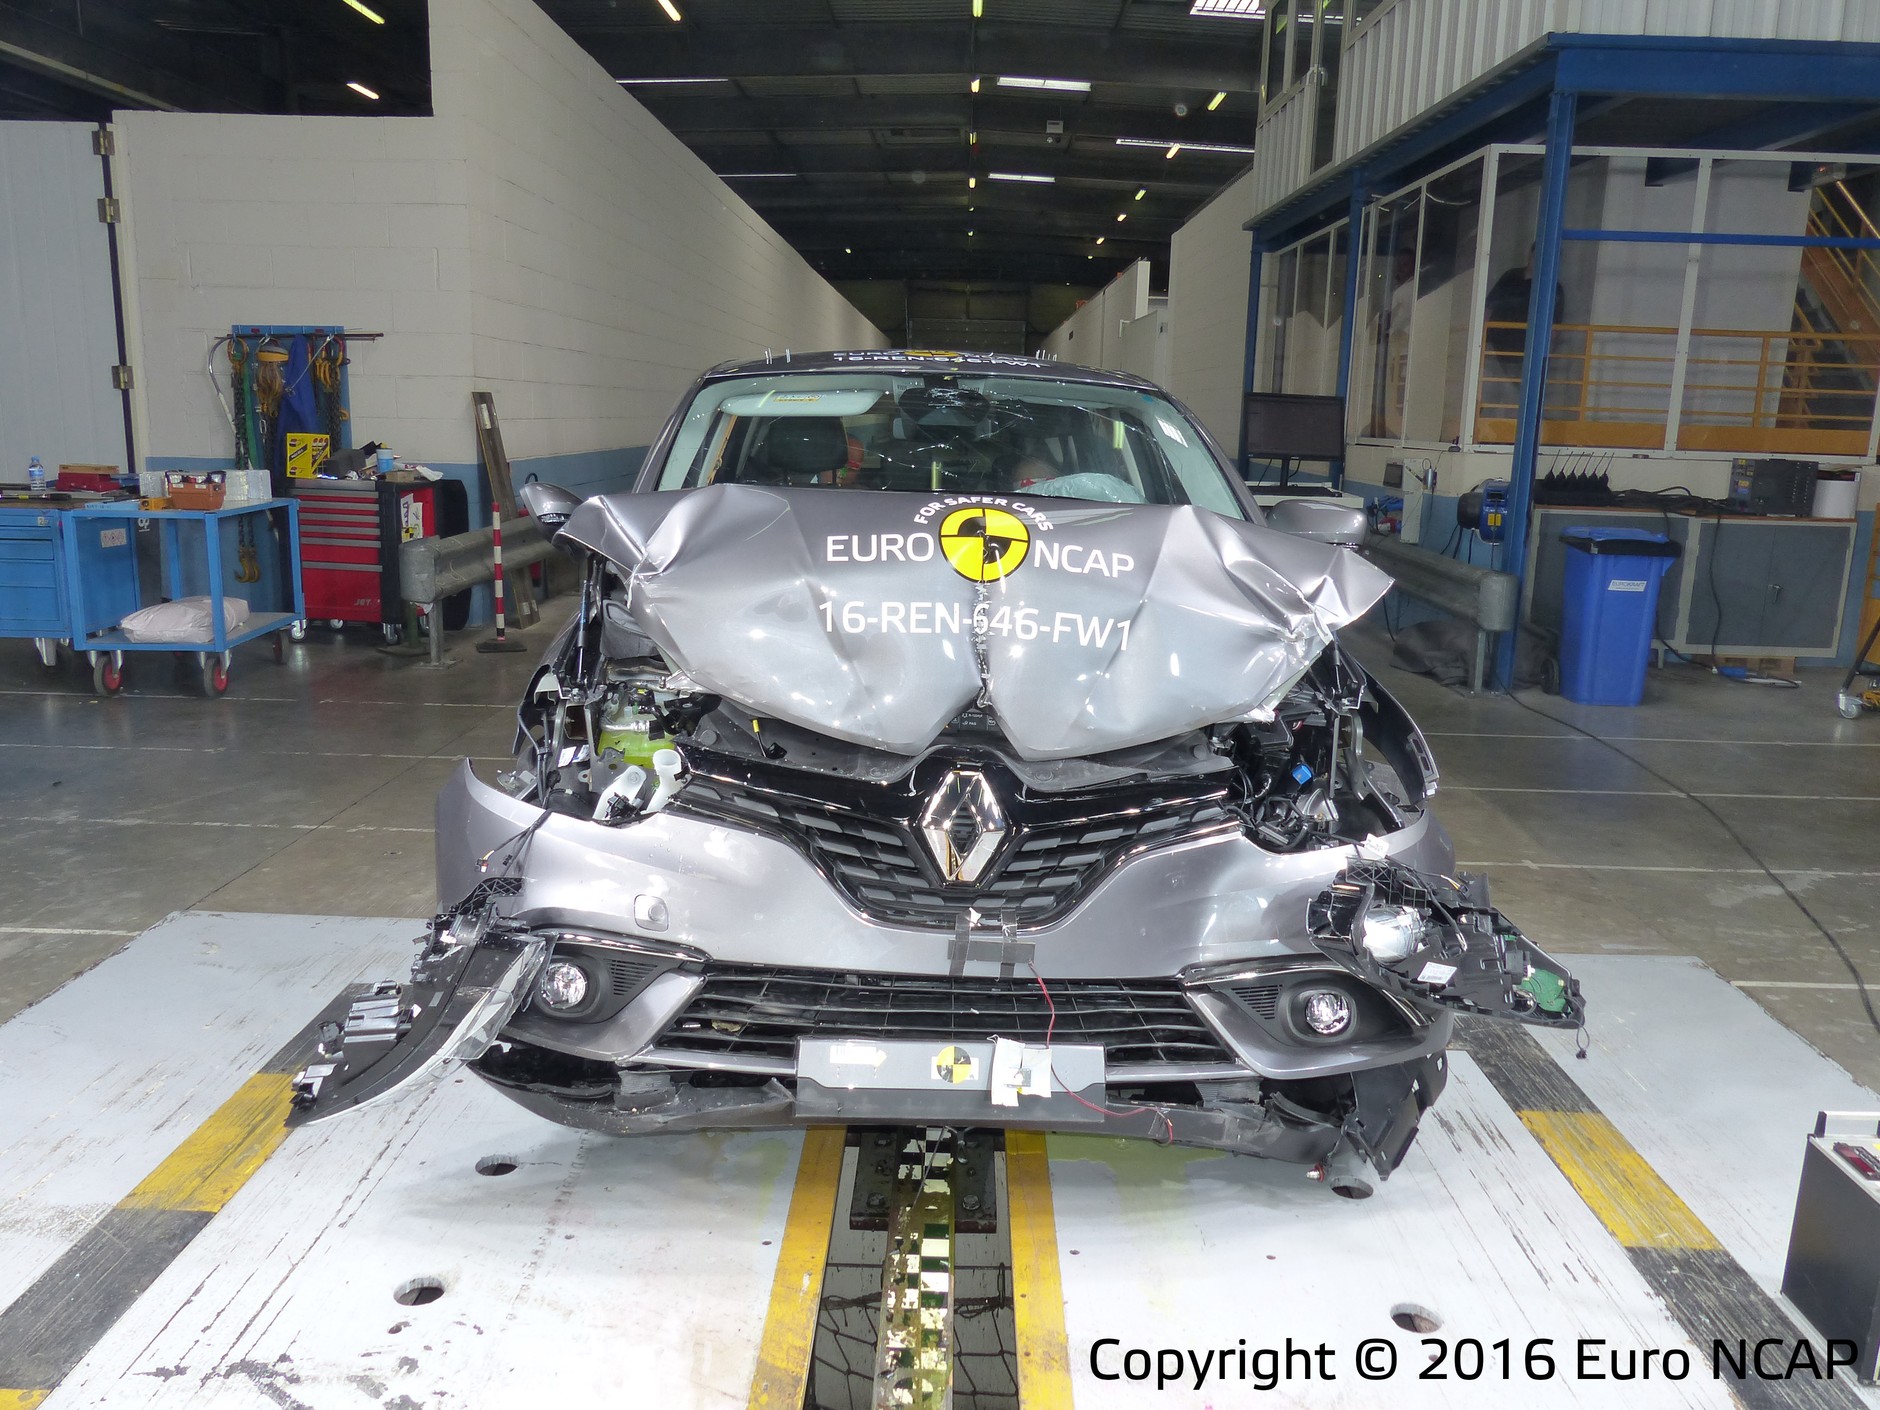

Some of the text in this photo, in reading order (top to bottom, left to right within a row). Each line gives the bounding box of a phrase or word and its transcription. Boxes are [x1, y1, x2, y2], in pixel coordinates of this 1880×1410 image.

[913, 496, 1055, 532] FOR SAFER CARS
[826, 532, 1135, 578] EURO NCAP
[819, 600, 1132, 652] 16-REN-646-FW1
